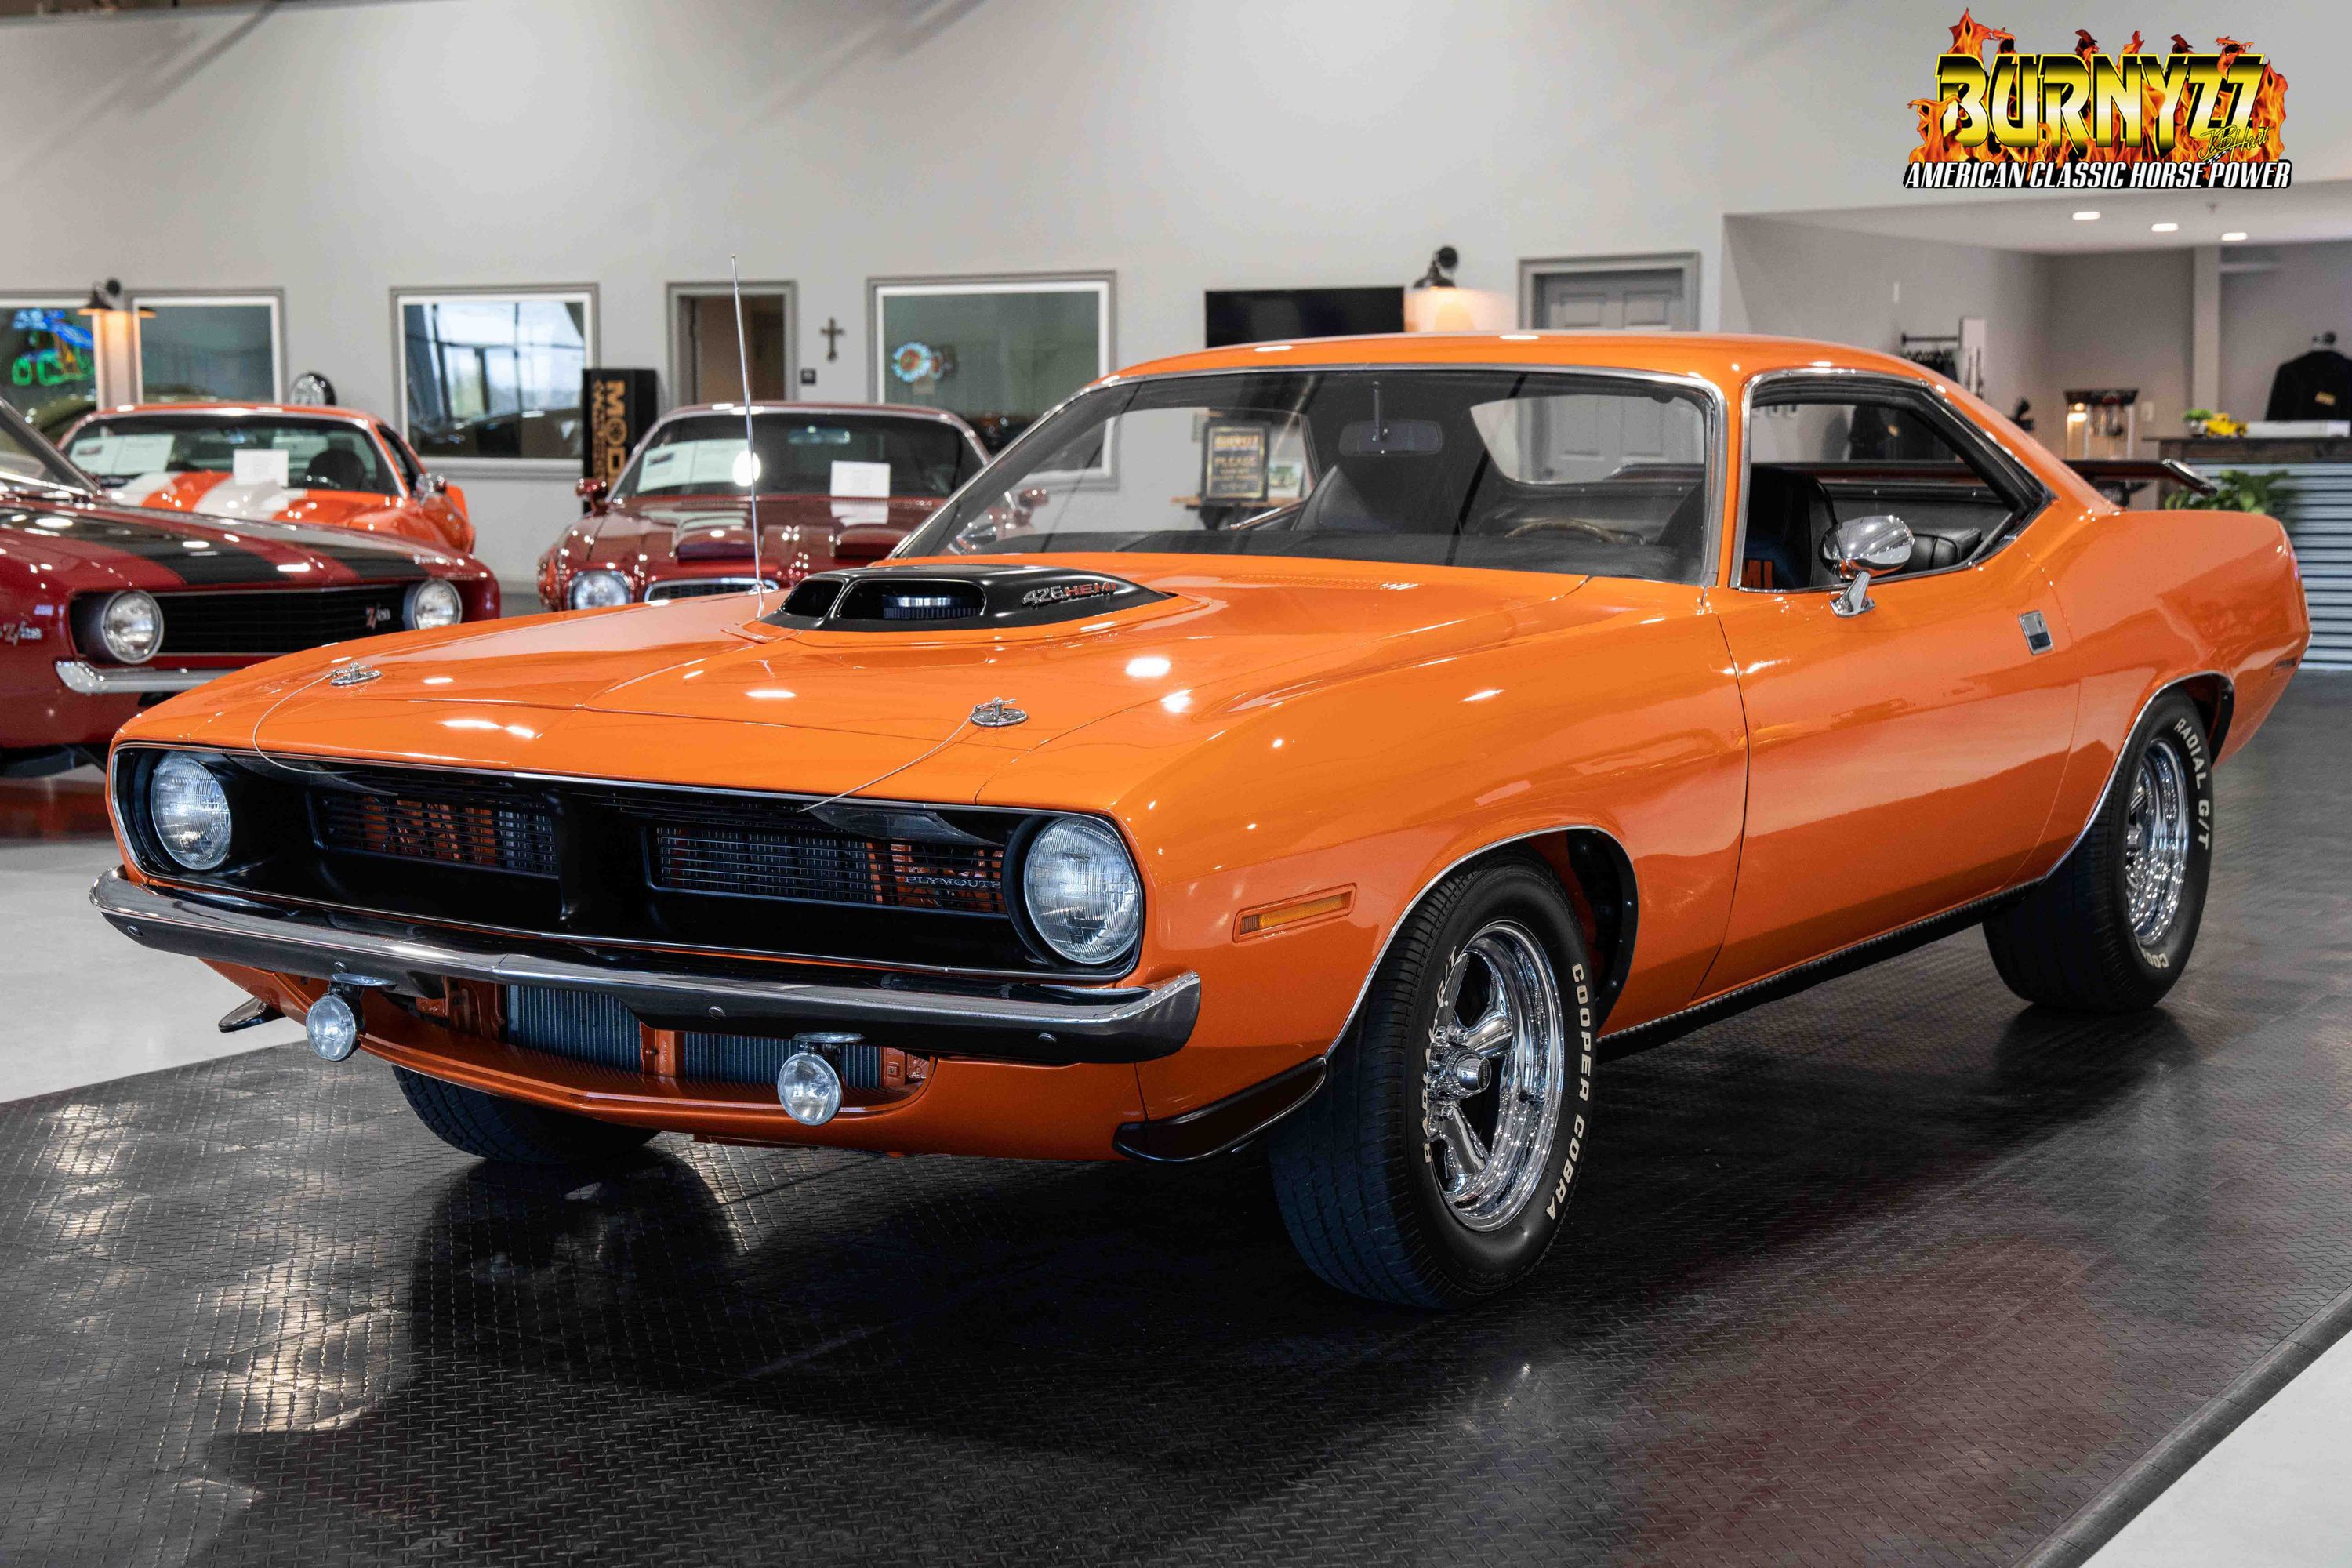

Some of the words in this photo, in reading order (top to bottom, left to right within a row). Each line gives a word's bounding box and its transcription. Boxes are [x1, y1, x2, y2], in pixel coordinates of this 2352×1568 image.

[1022, 585, 1064, 605] 426
[1065, 582, 1116, 598] HEMI
[2173, 717, 2207, 790] RADIAL
[2198, 799, 2209, 850] G/T
[904, 876, 1001, 888] PLYMOUTH
[1572, 964, 1591, 1102] COOPER
[1546, 1114, 1584, 1220] COBRA
